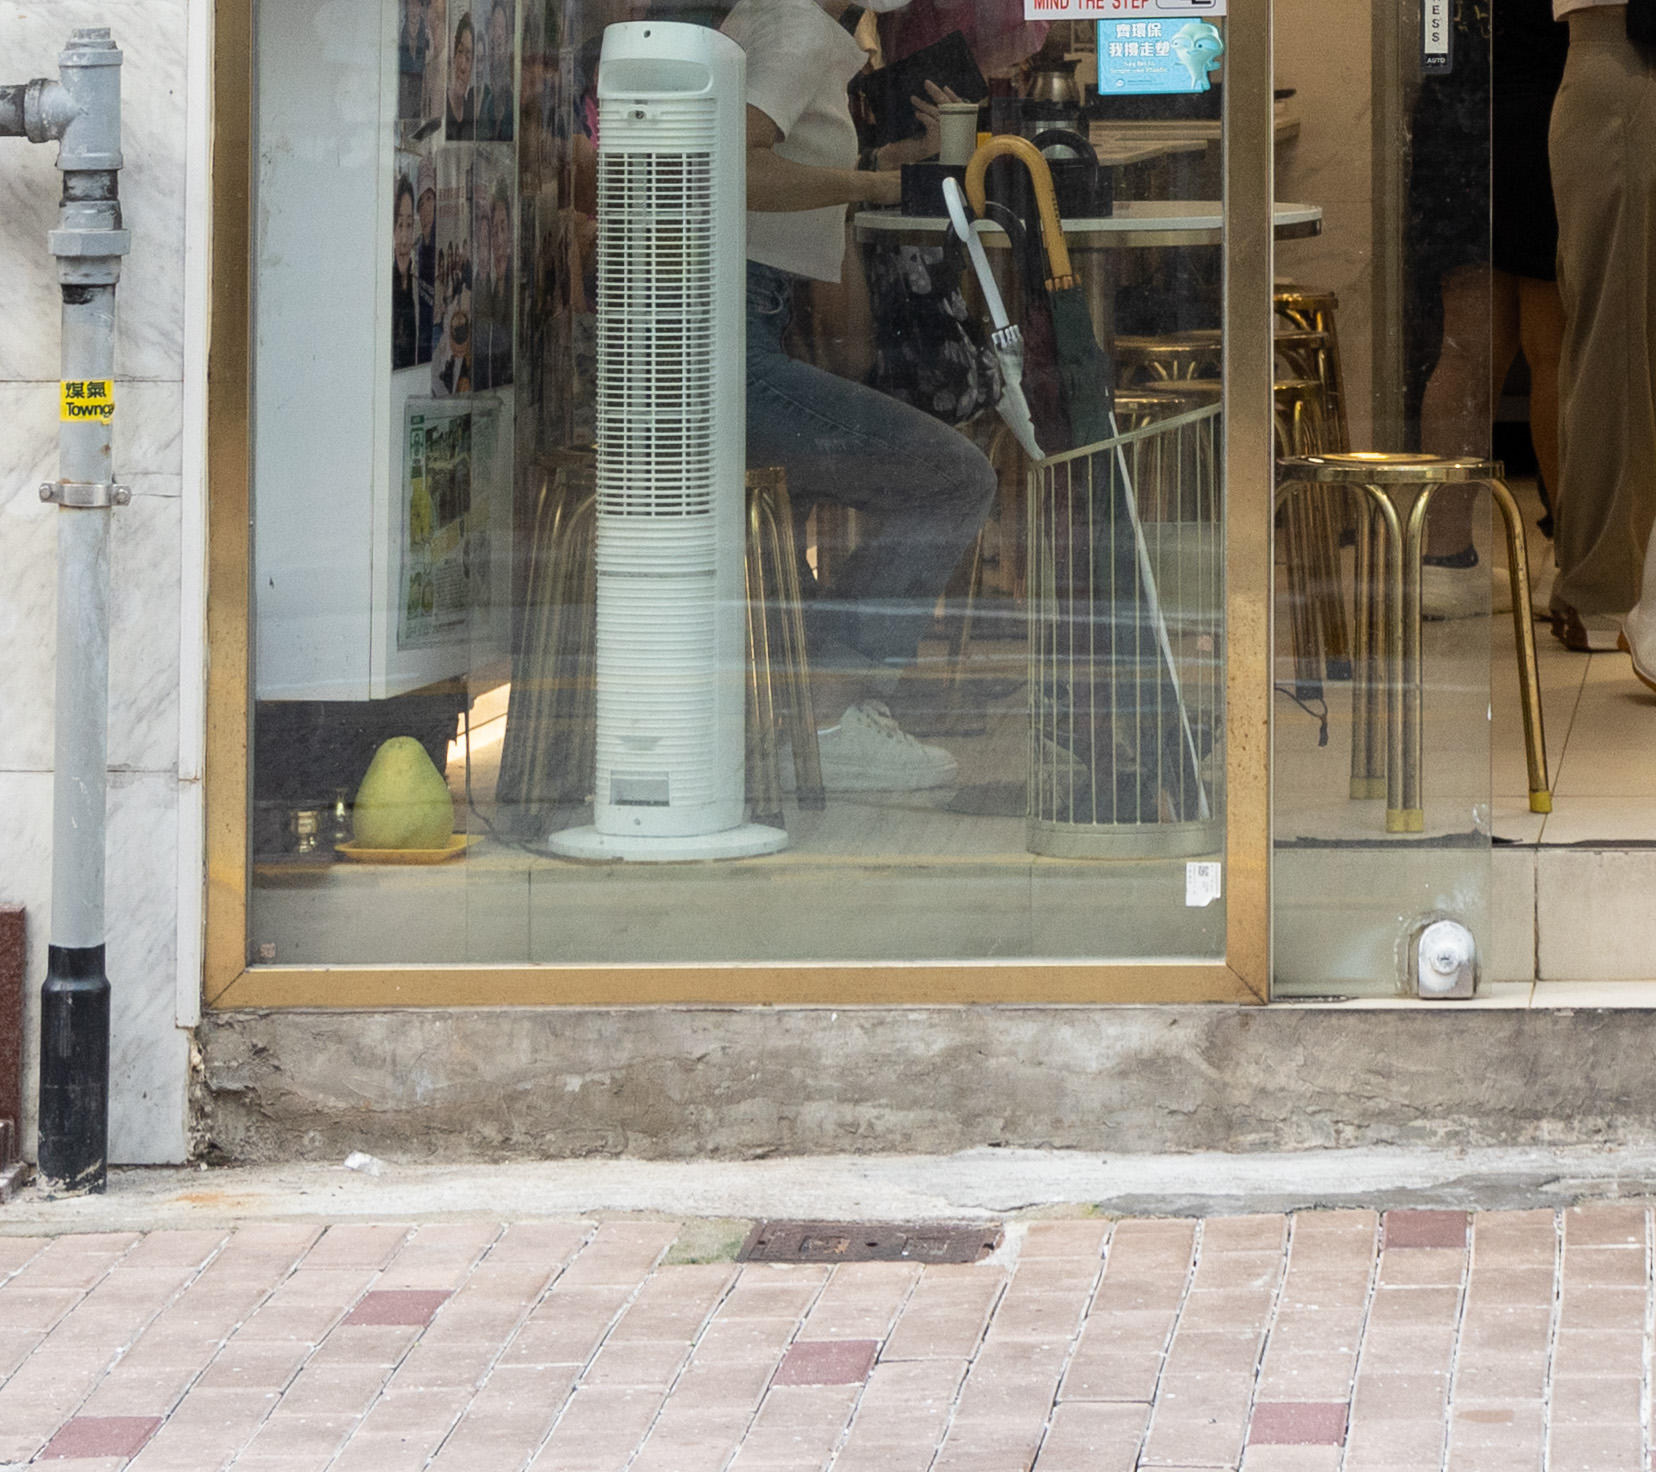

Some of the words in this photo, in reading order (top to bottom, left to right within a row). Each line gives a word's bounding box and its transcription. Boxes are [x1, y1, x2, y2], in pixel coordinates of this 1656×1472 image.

[1115, 22, 1163, 39] 齊環保
[1427, 56, 1446, 64] AUTO
[65, 381, 107, 399] 煤氣
